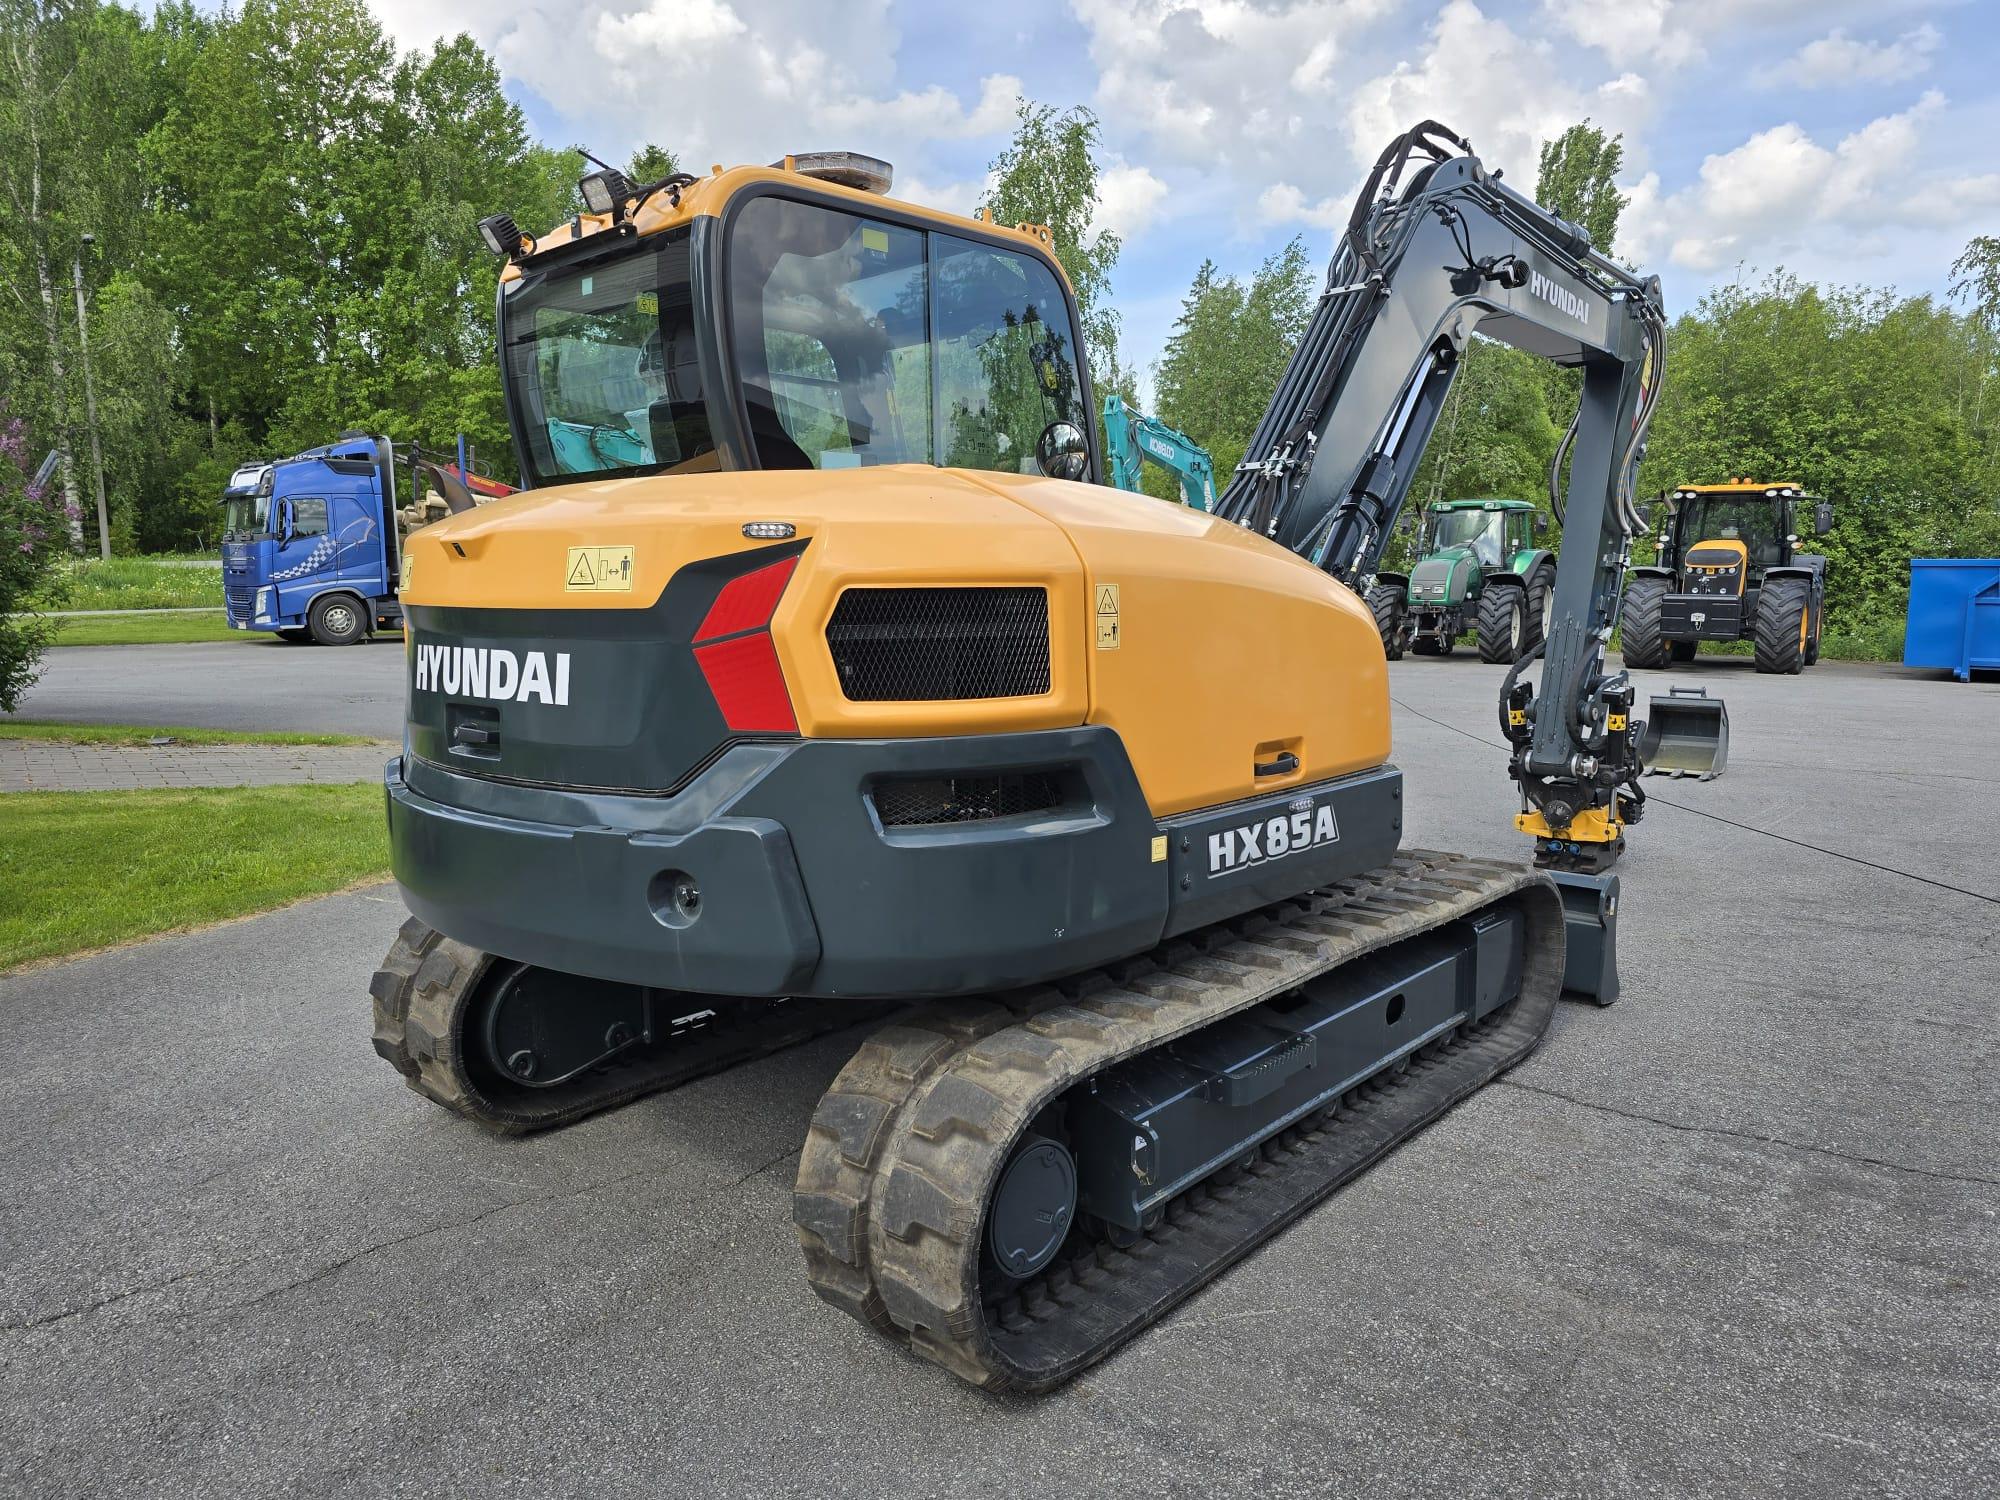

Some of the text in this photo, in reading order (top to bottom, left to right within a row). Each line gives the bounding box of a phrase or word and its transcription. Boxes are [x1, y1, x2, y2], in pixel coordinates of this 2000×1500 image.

[1530, 270, 1590, 325] HYUNDAI
[416, 644, 571, 706] HYUNDAI
[1208, 804, 1338, 874] HX85A
